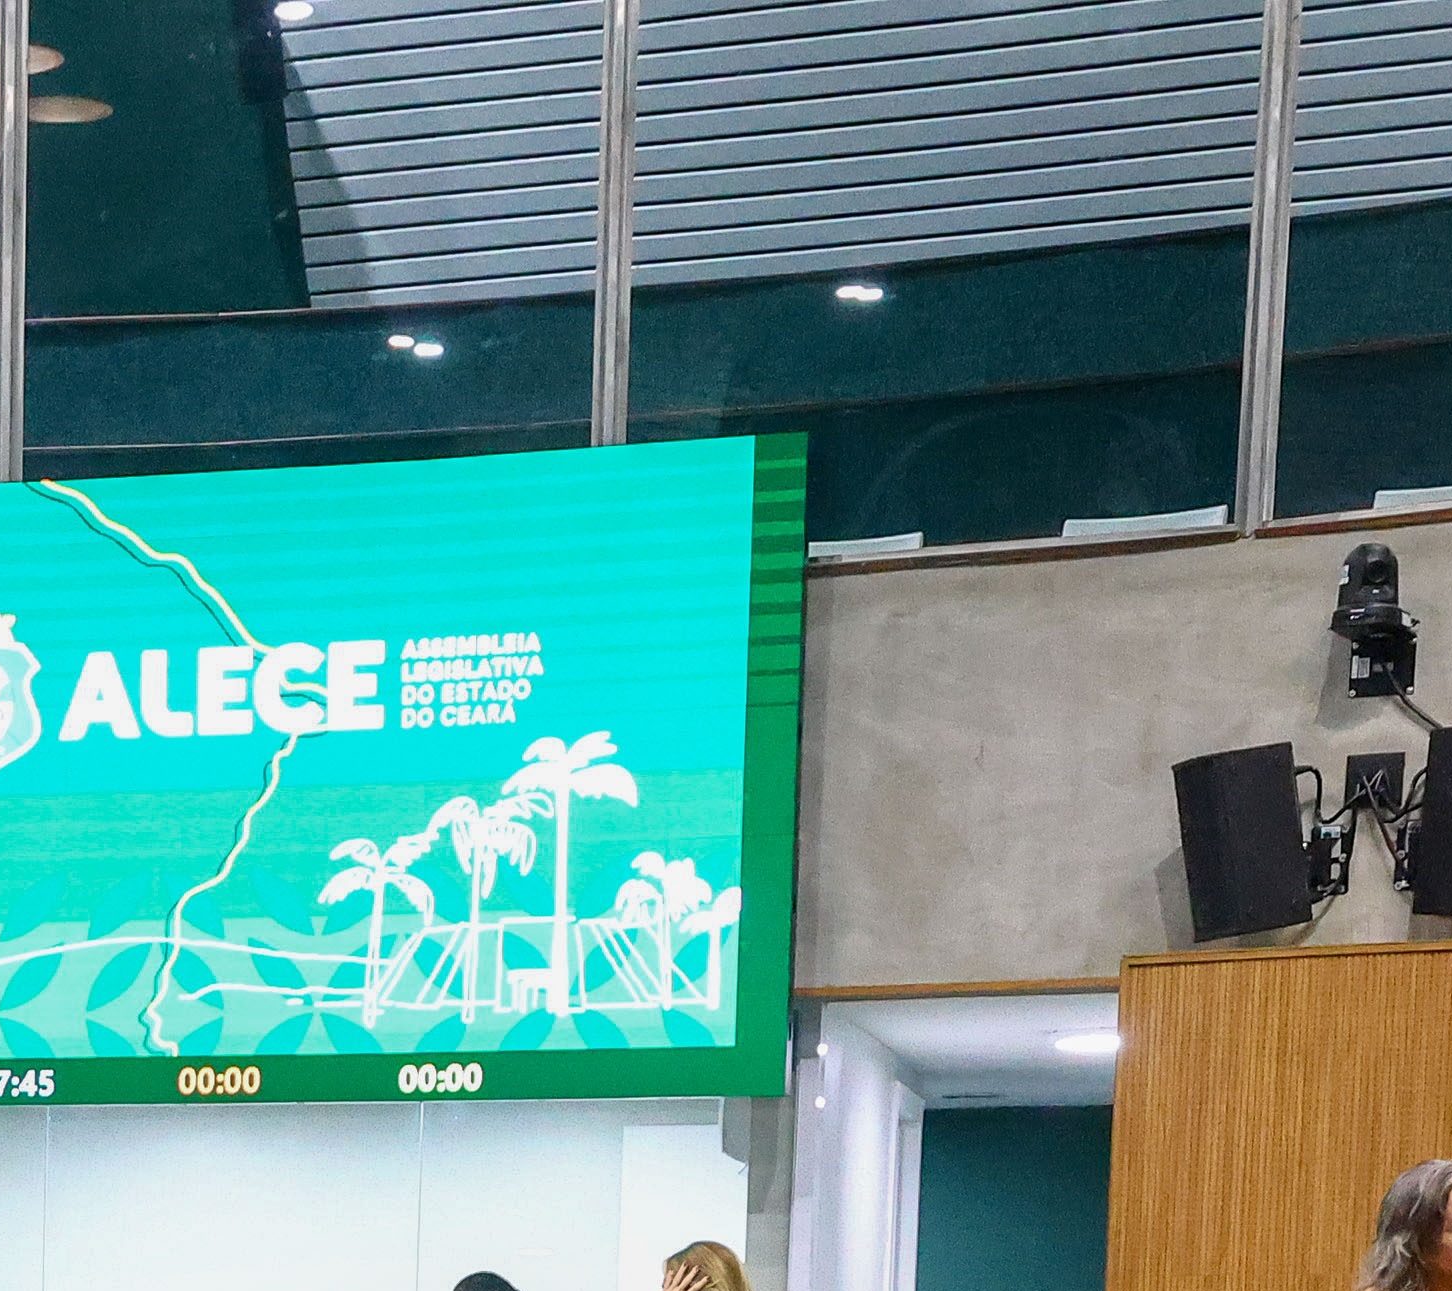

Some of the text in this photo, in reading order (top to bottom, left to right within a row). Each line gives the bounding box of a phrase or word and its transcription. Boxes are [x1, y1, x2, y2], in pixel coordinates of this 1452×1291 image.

[400, 632, 542, 660] ASSEMBLEIA
[400, 654, 544, 682] LEGISLATIVA
[58, 641, 387, 741] ALECE
[400, 678, 532, 706] DO ESTADO
[400, 698, 516, 729] DO CEARÁ
[177, 1065, 262, 1096] 00:00
[397, 1062, 483, 1093] 00:00
